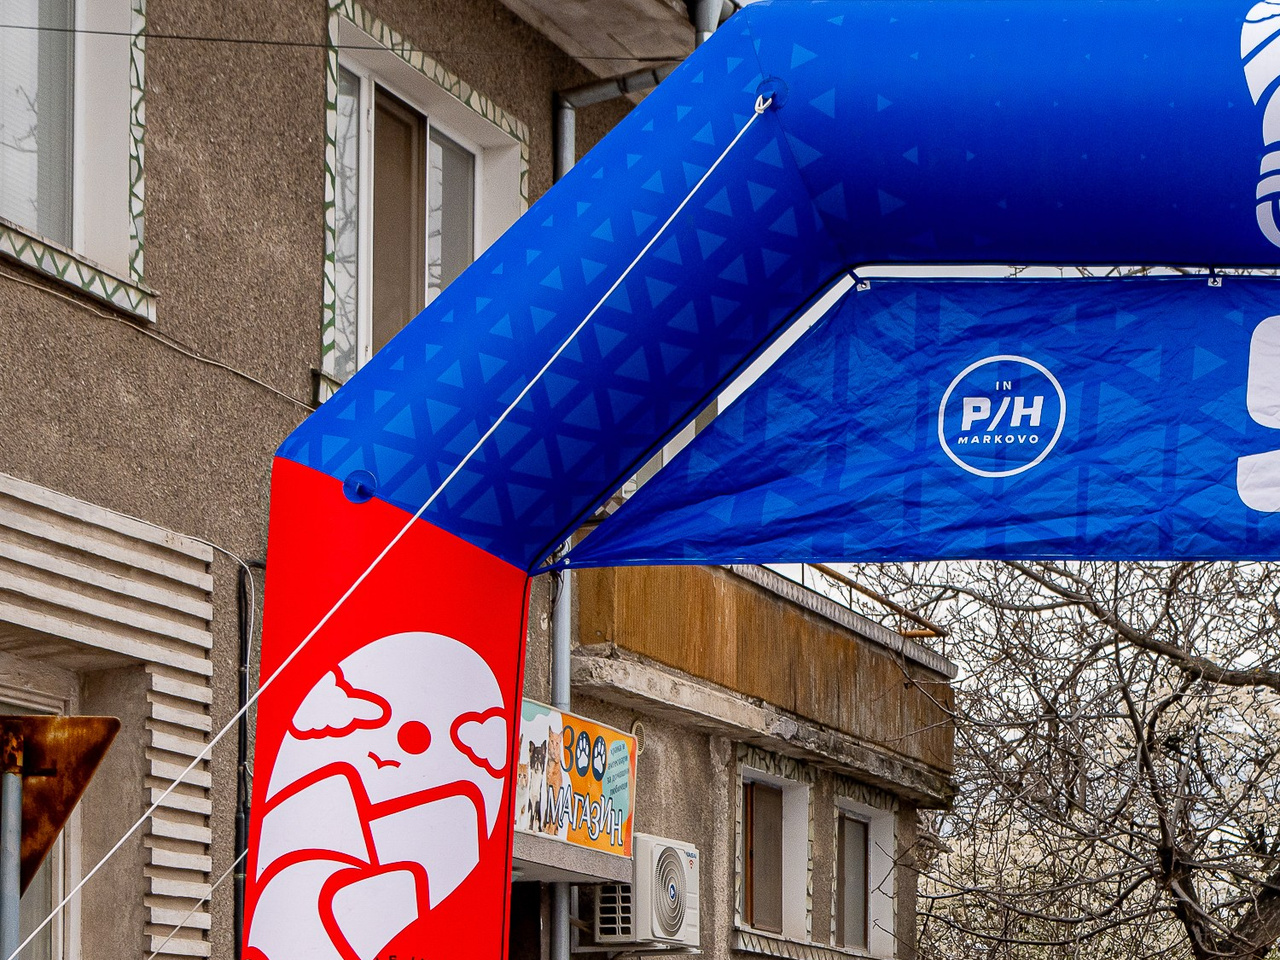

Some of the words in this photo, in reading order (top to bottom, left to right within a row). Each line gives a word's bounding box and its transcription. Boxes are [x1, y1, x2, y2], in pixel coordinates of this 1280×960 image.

[995, 381, 1012, 391] IN
[961, 395, 1044, 432] P/H
[957, 434, 1039, 445] MARKOVO
[546, 784, 623, 847] МАГАЗИН
